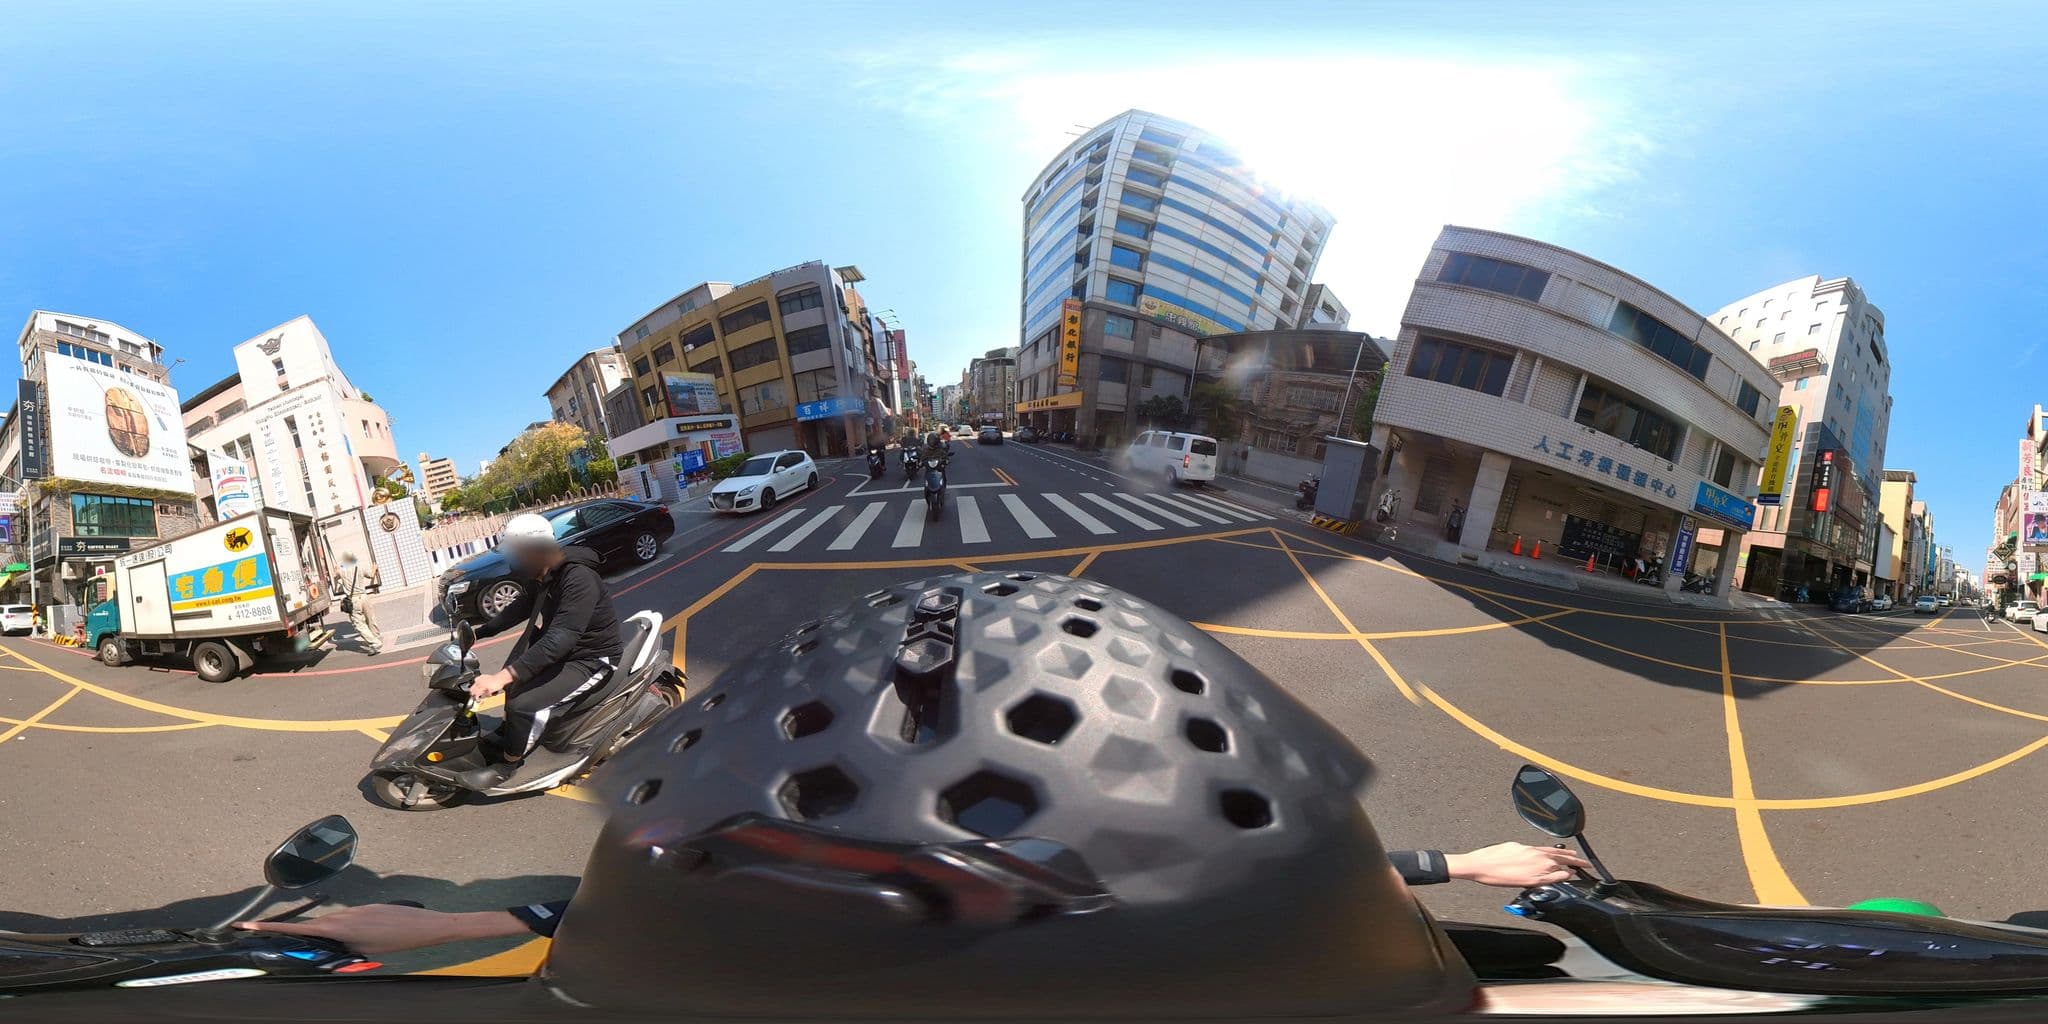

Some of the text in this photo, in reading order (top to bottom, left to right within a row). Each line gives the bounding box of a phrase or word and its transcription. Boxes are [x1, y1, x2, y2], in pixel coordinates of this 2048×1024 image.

[1067, 315, 1078, 362] 彰化銀行
[176, 558, 257, 599] 宅急便
